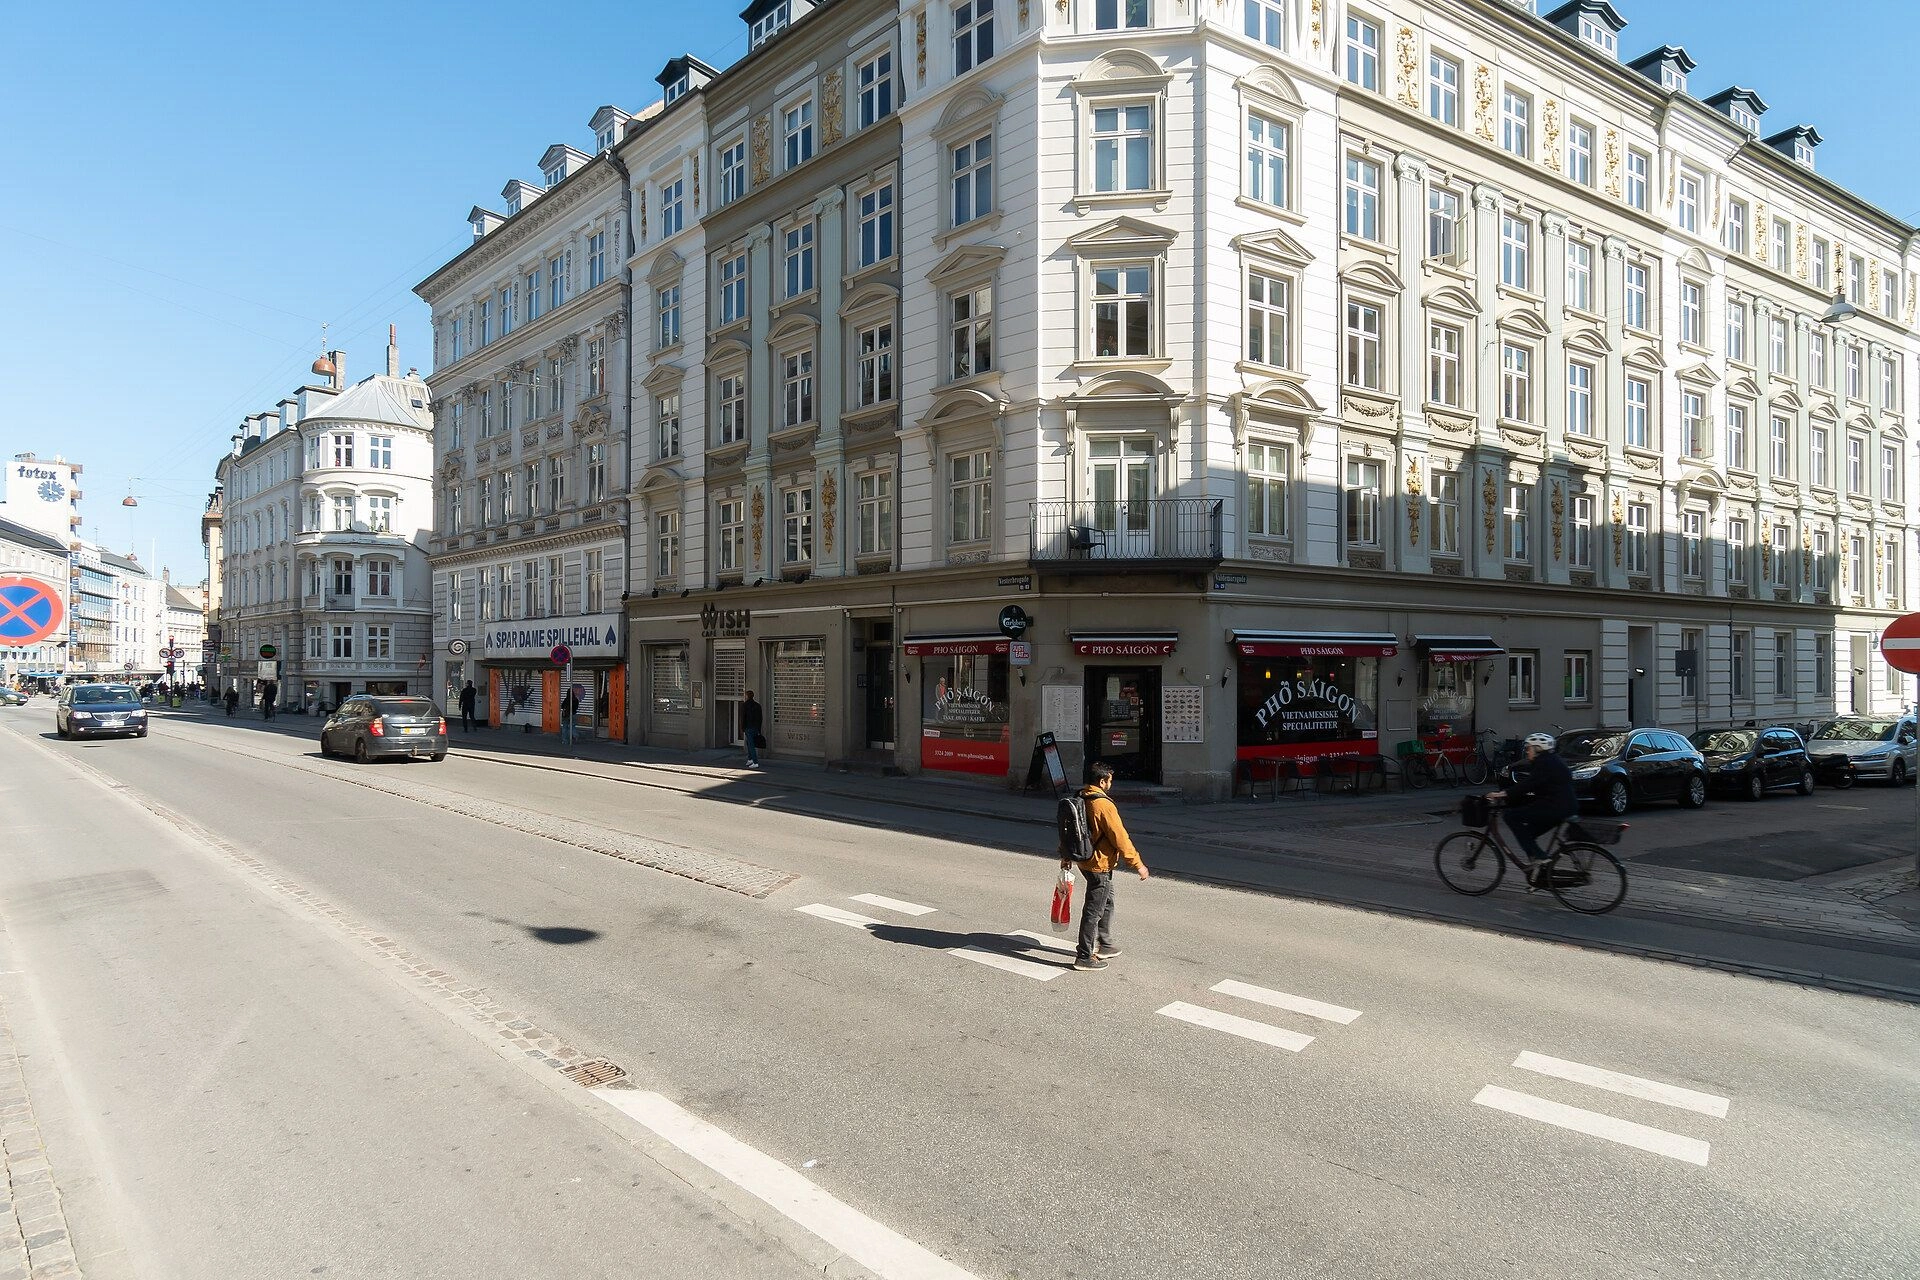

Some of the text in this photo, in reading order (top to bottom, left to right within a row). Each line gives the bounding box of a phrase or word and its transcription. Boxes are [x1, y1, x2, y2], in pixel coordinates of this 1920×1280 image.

[700, 604, 750, 629] WISH
[496, 626, 600, 648] SPAR DAME SPILLEHAL
[933, 646, 948, 654] PHO
[1092, 646, 1114, 654] PHO
[1300, 647, 1316, 655] PHO
[1282, 710, 1339, 720] VIETNAMESISKE
[1282, 721, 1338, 731] SPECIALITETER
